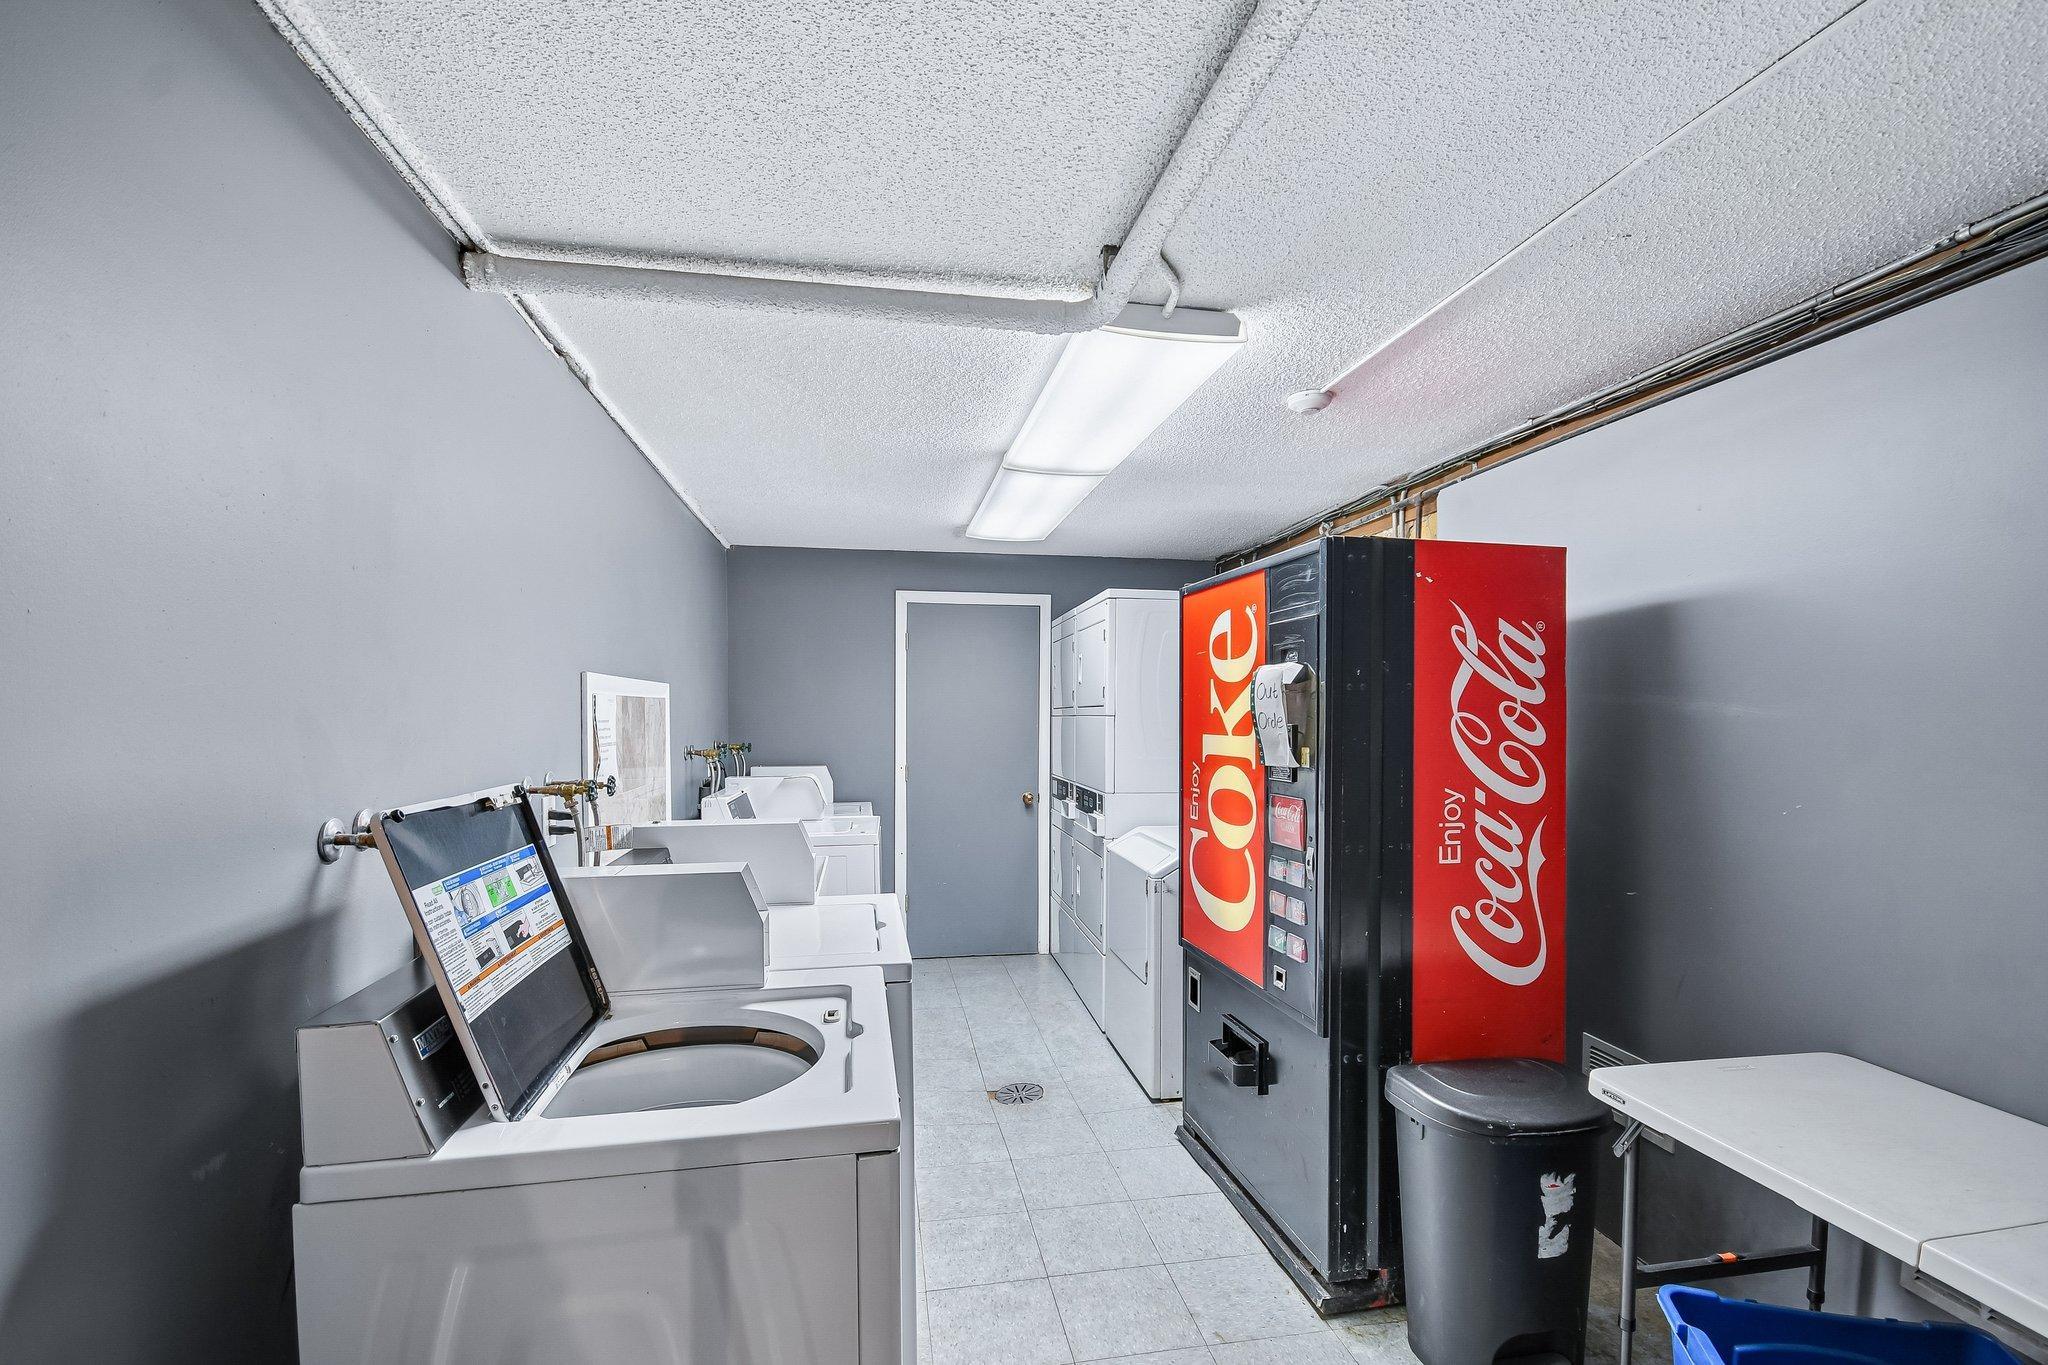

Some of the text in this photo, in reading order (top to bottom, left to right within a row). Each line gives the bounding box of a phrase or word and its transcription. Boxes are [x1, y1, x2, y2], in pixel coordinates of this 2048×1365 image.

[1256, 682, 1279, 700] Out
[1189, 604, 1258, 932] Coke
[1190, 761, 1201, 821] Enjoy
[1448, 599, 1547, 986] Coca-Cola
[1438, 787, 1466, 865] Enjoy
